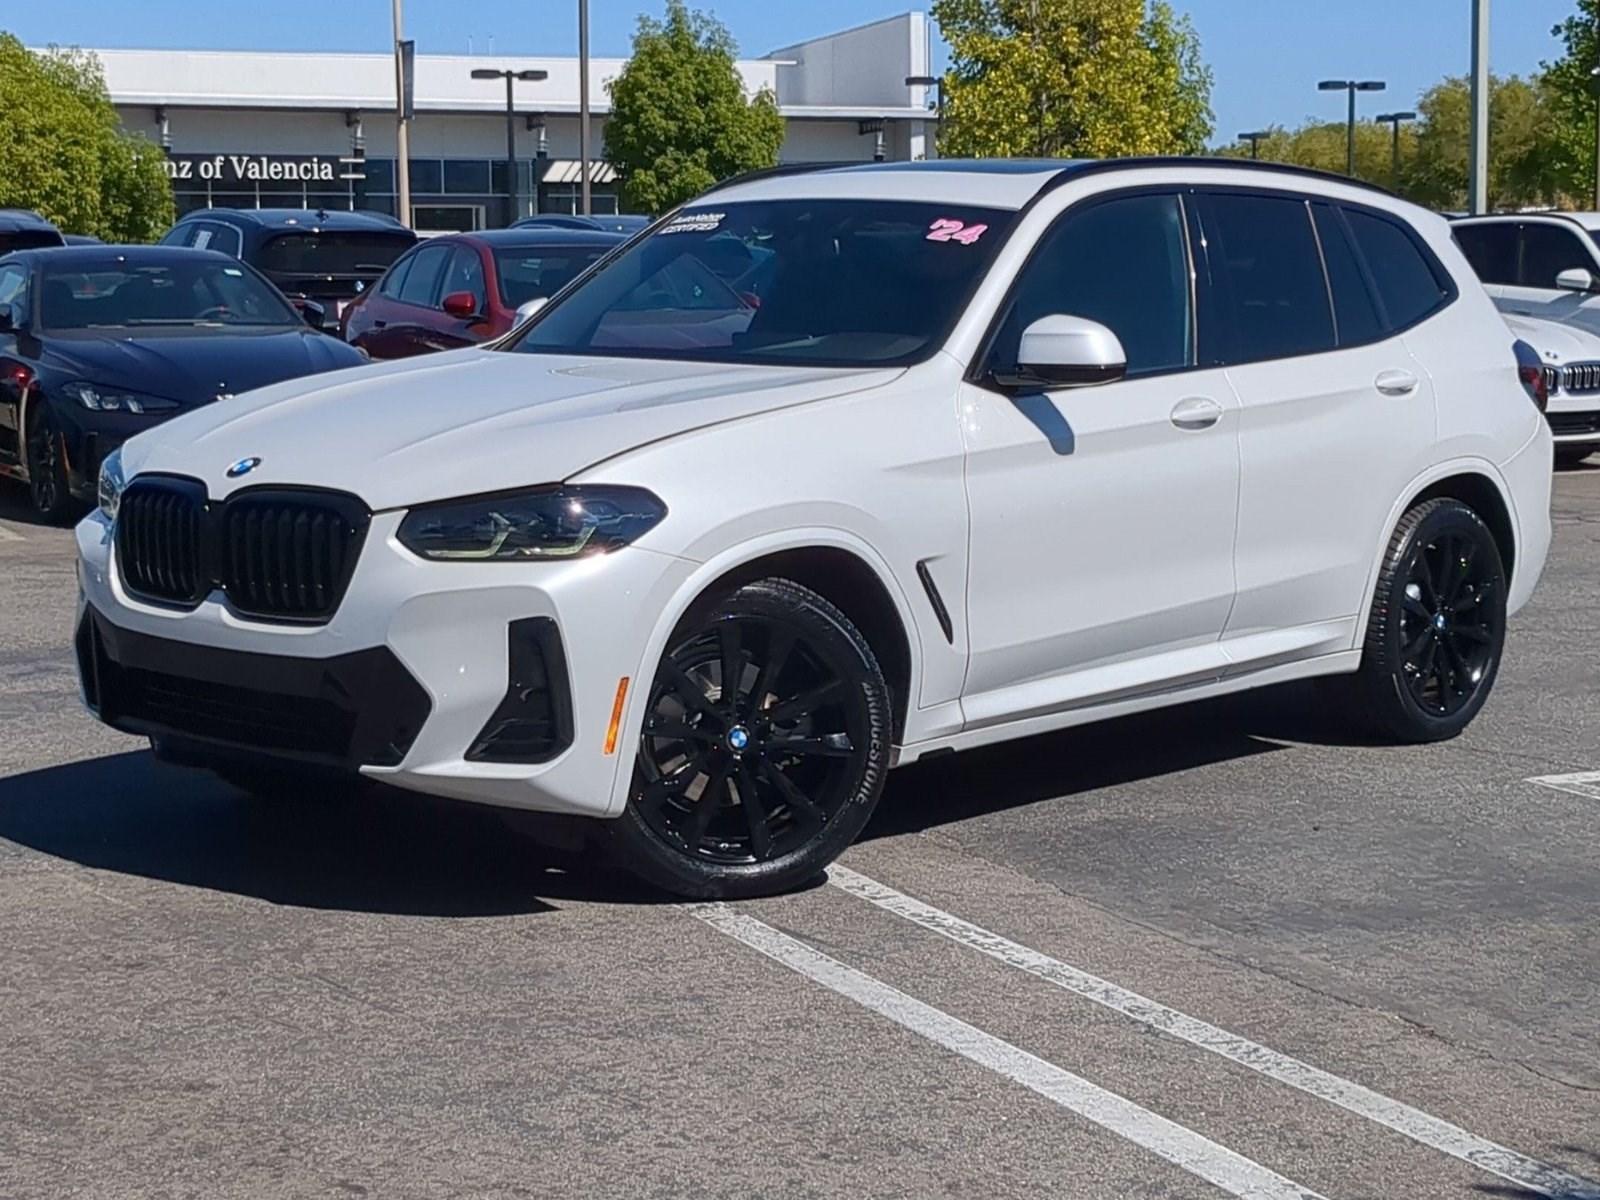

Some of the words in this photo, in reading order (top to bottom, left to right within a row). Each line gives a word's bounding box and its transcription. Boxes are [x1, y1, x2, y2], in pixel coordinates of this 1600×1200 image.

[163, 160, 192, 178] nz
[199, 156, 224, 179] of
[229, 156, 334, 180] Valencia
